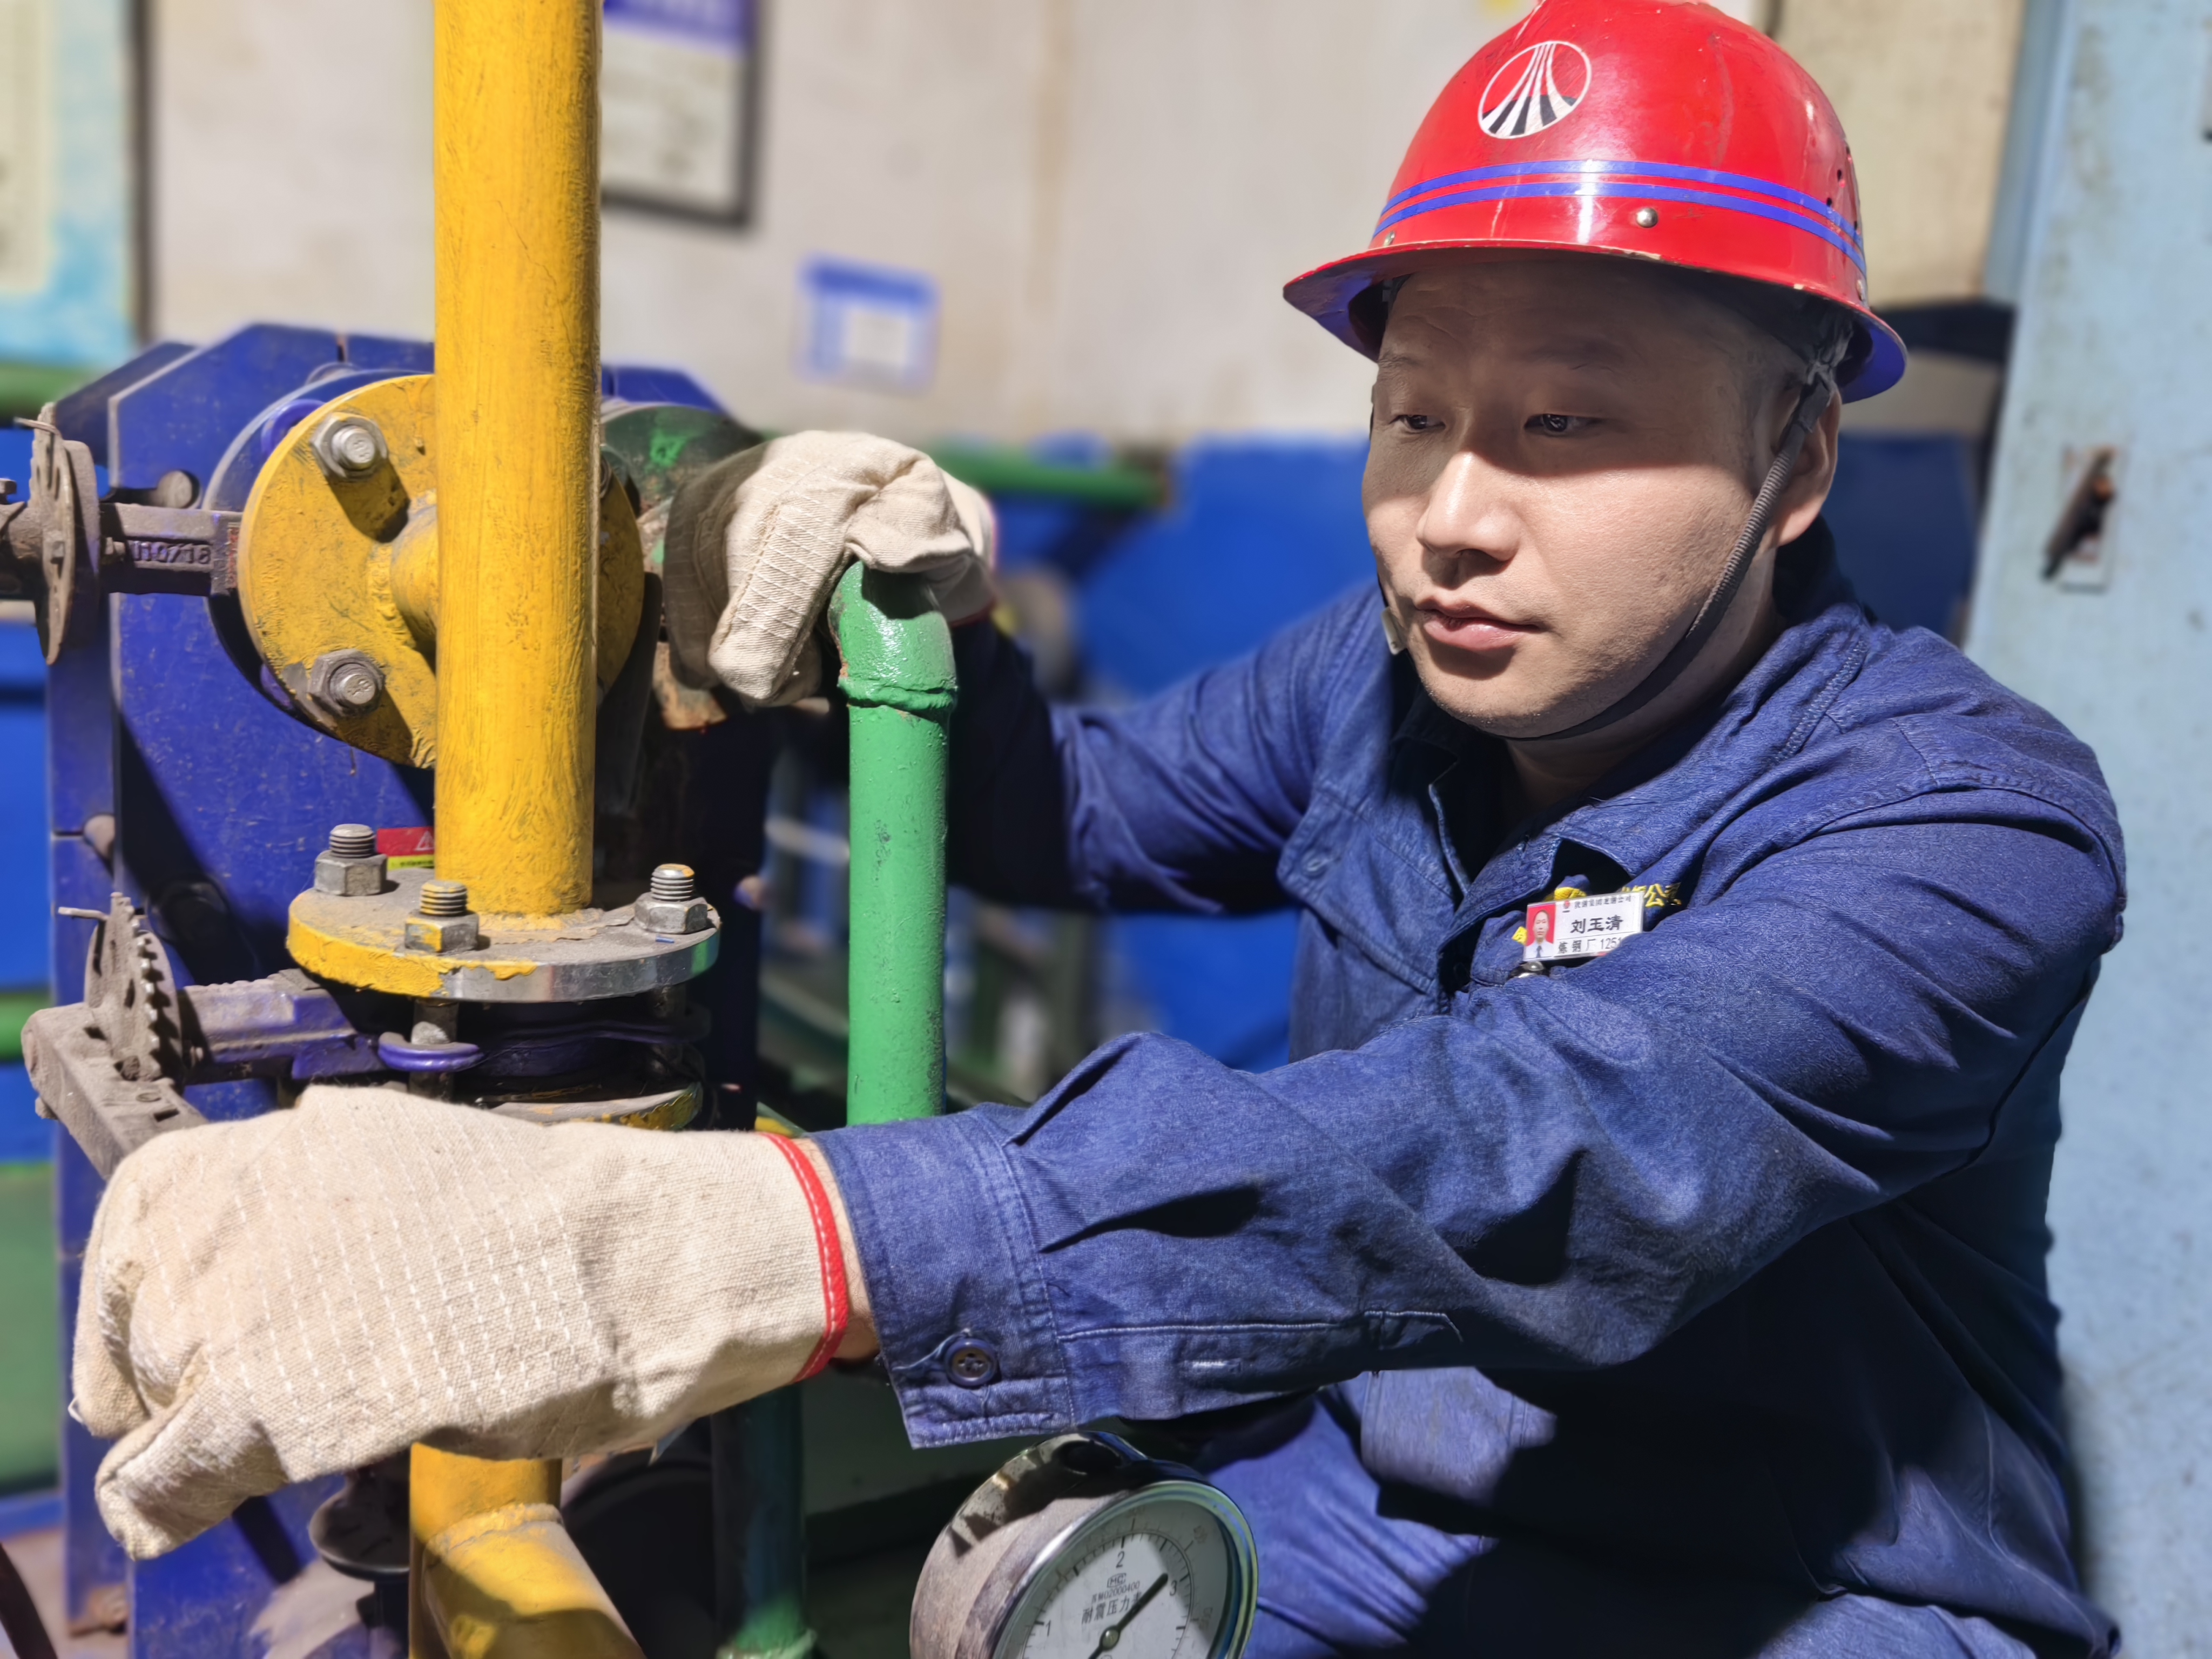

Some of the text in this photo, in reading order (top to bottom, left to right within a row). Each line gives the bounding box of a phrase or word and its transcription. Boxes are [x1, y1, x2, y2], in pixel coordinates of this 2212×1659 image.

[1570, 915, 1623, 934] 刘玉清
[1116, 1550, 1125, 1568] 2
[1169, 1580, 1177, 1596] 3
[1046, 1620, 1051, 1637] 1
